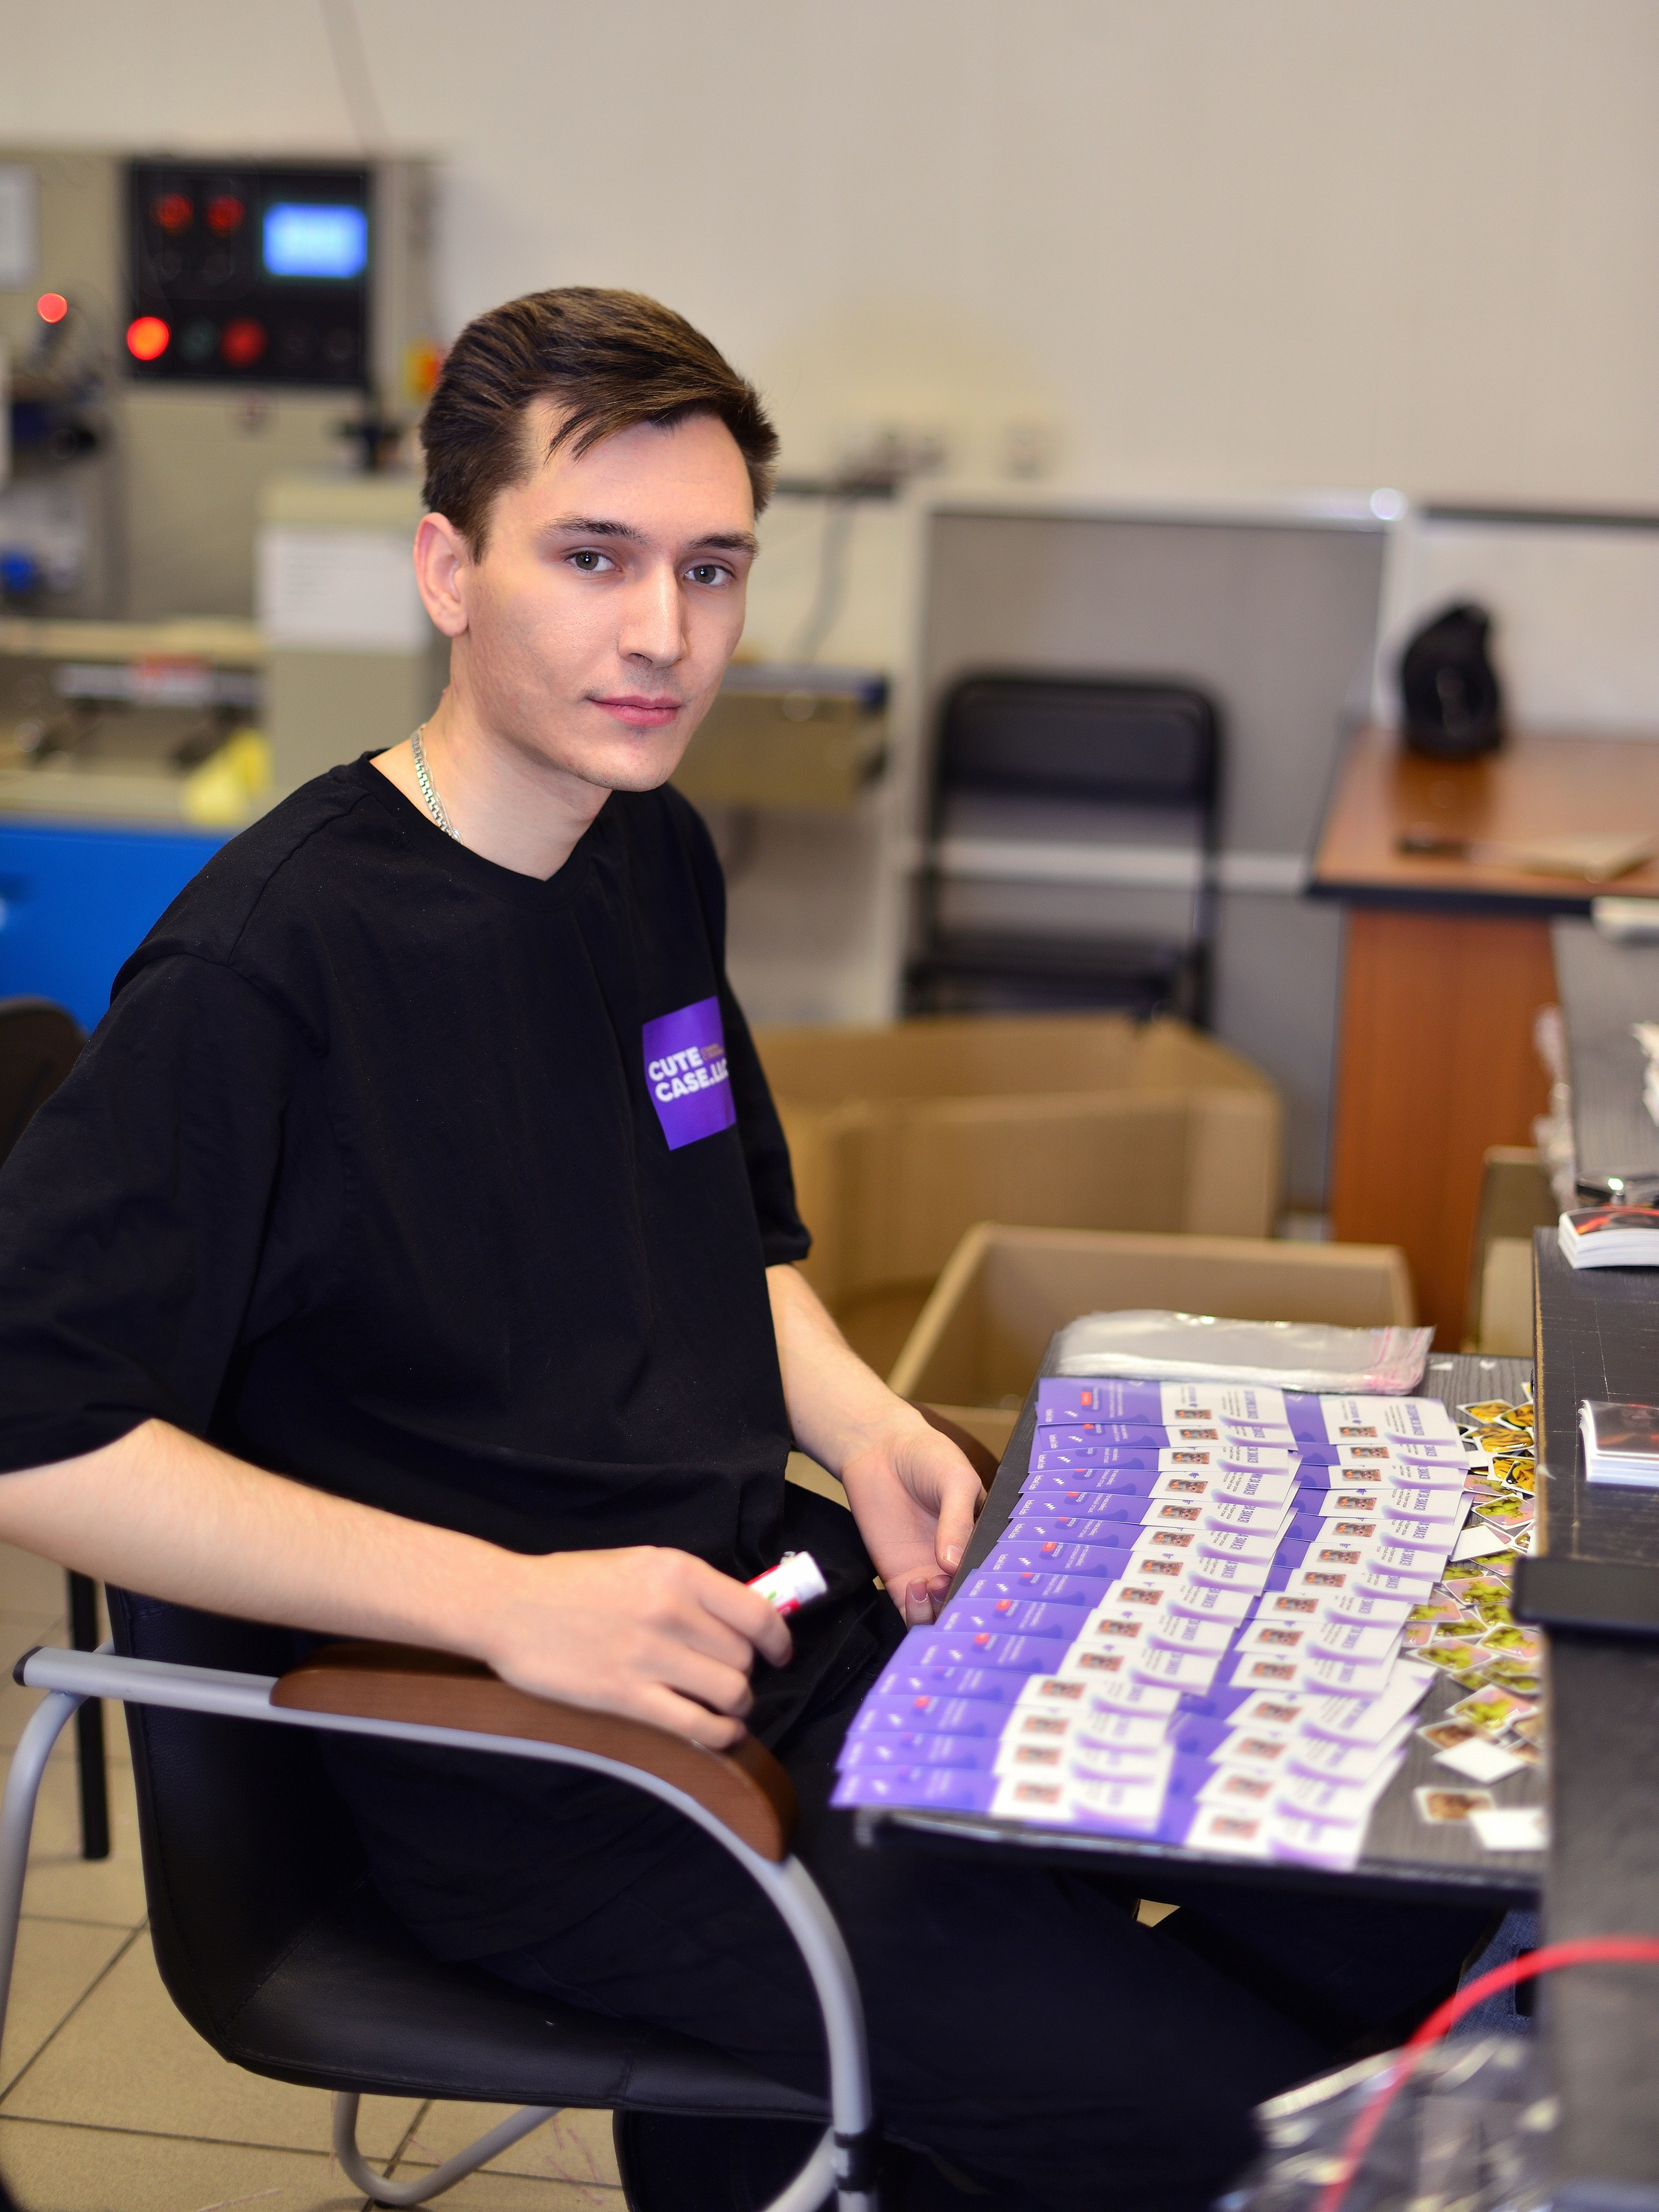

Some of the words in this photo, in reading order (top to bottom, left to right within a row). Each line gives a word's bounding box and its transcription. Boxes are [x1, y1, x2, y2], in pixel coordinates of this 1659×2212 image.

[648, 1046, 704, 1082] CUTE
[1028, 1474, 1043, 1490] label.lab
[1242, 1484, 1259, 1496] ЗАКАЗ!
[1018, 1499, 1035, 1515] label.lab
[1413, 1498, 1428, 1511] ЗАКАЗ!
[1236, 1510, 1254, 1523] ЗАКАЗ!
[1008, 1523, 1025, 1539] label.lab
[1411, 1526, 1430, 1539] ЗАКАЗ!
[1229, 1537, 1247, 1550] ЗАКАЗ!
[993, 1554, 1009, 1570] label.lab
[1398, 1553, 1415, 1566] ЗАКАЗ!
[1220, 1565, 1238, 1579] ЗАКАЗ!
